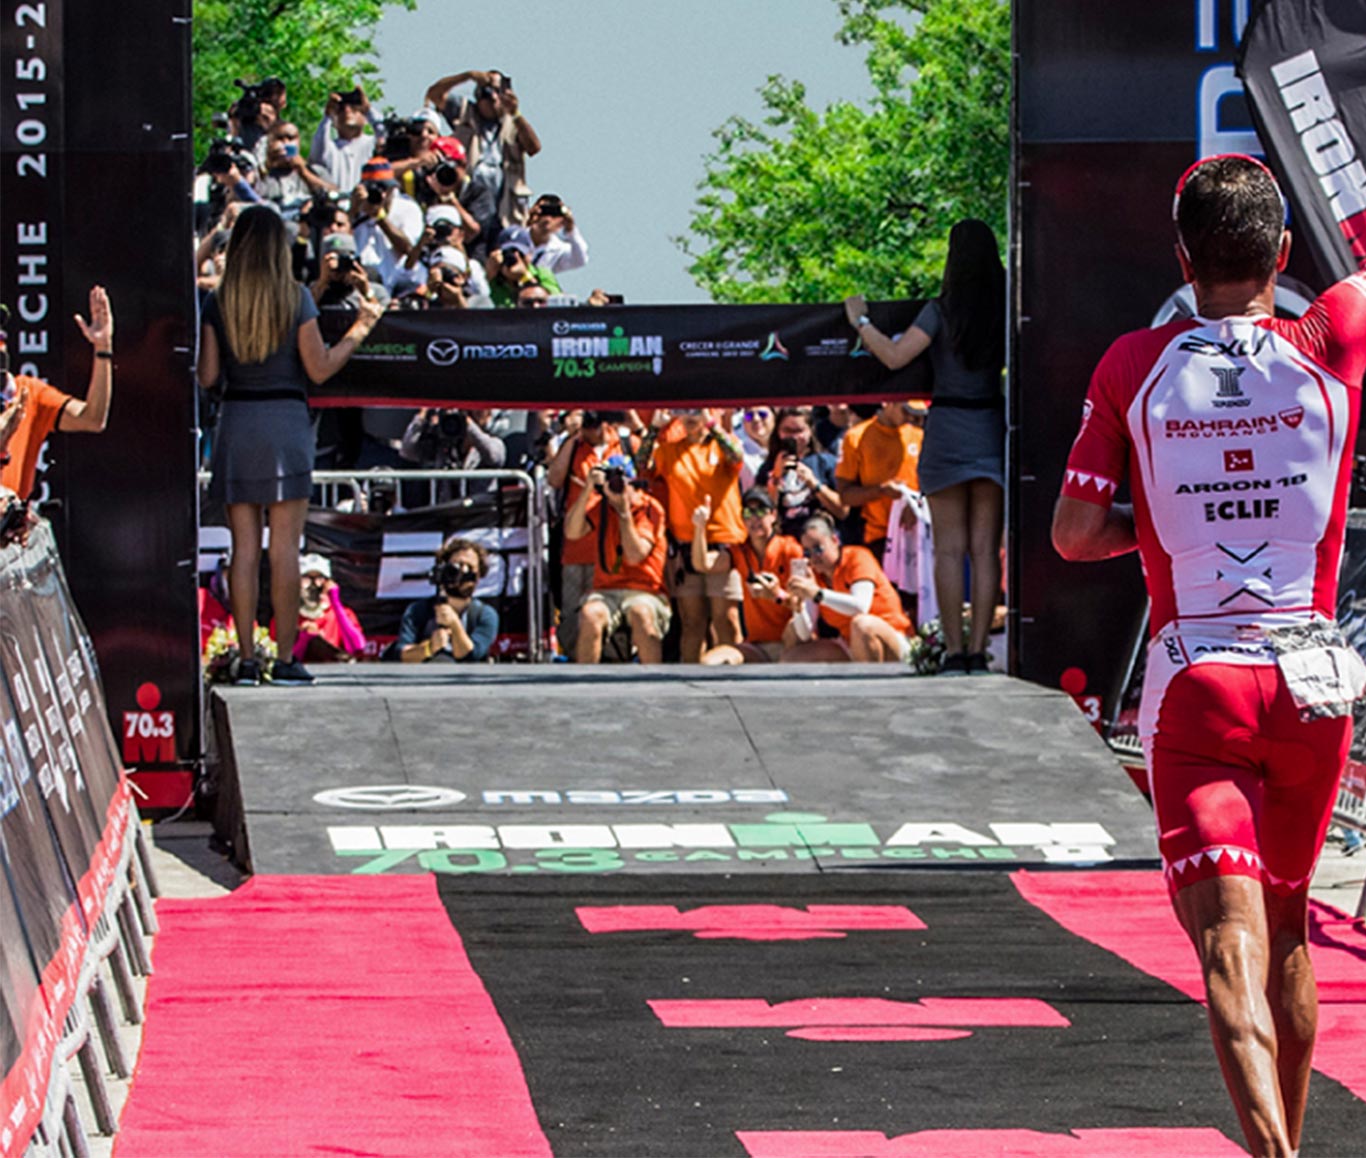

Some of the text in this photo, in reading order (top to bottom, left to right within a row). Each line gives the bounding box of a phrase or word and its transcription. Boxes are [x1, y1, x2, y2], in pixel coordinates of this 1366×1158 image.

[462, 343, 538, 358] mazda
[552, 327, 664, 357] IRONMAN
[553, 358, 596, 378] 70.3
[1165, 425, 1279, 438] ENDURANCE
[1166, 415, 1278, 431] BAHRAIN
[1175, 479, 1272, 494] ARGON
[126, 713, 174, 738] 70.3
[482, 790, 789, 804] mazda
[326, 812, 1116, 851] IRONMAN
[335, 846, 1017, 874] 70.3 CAMPECHE
